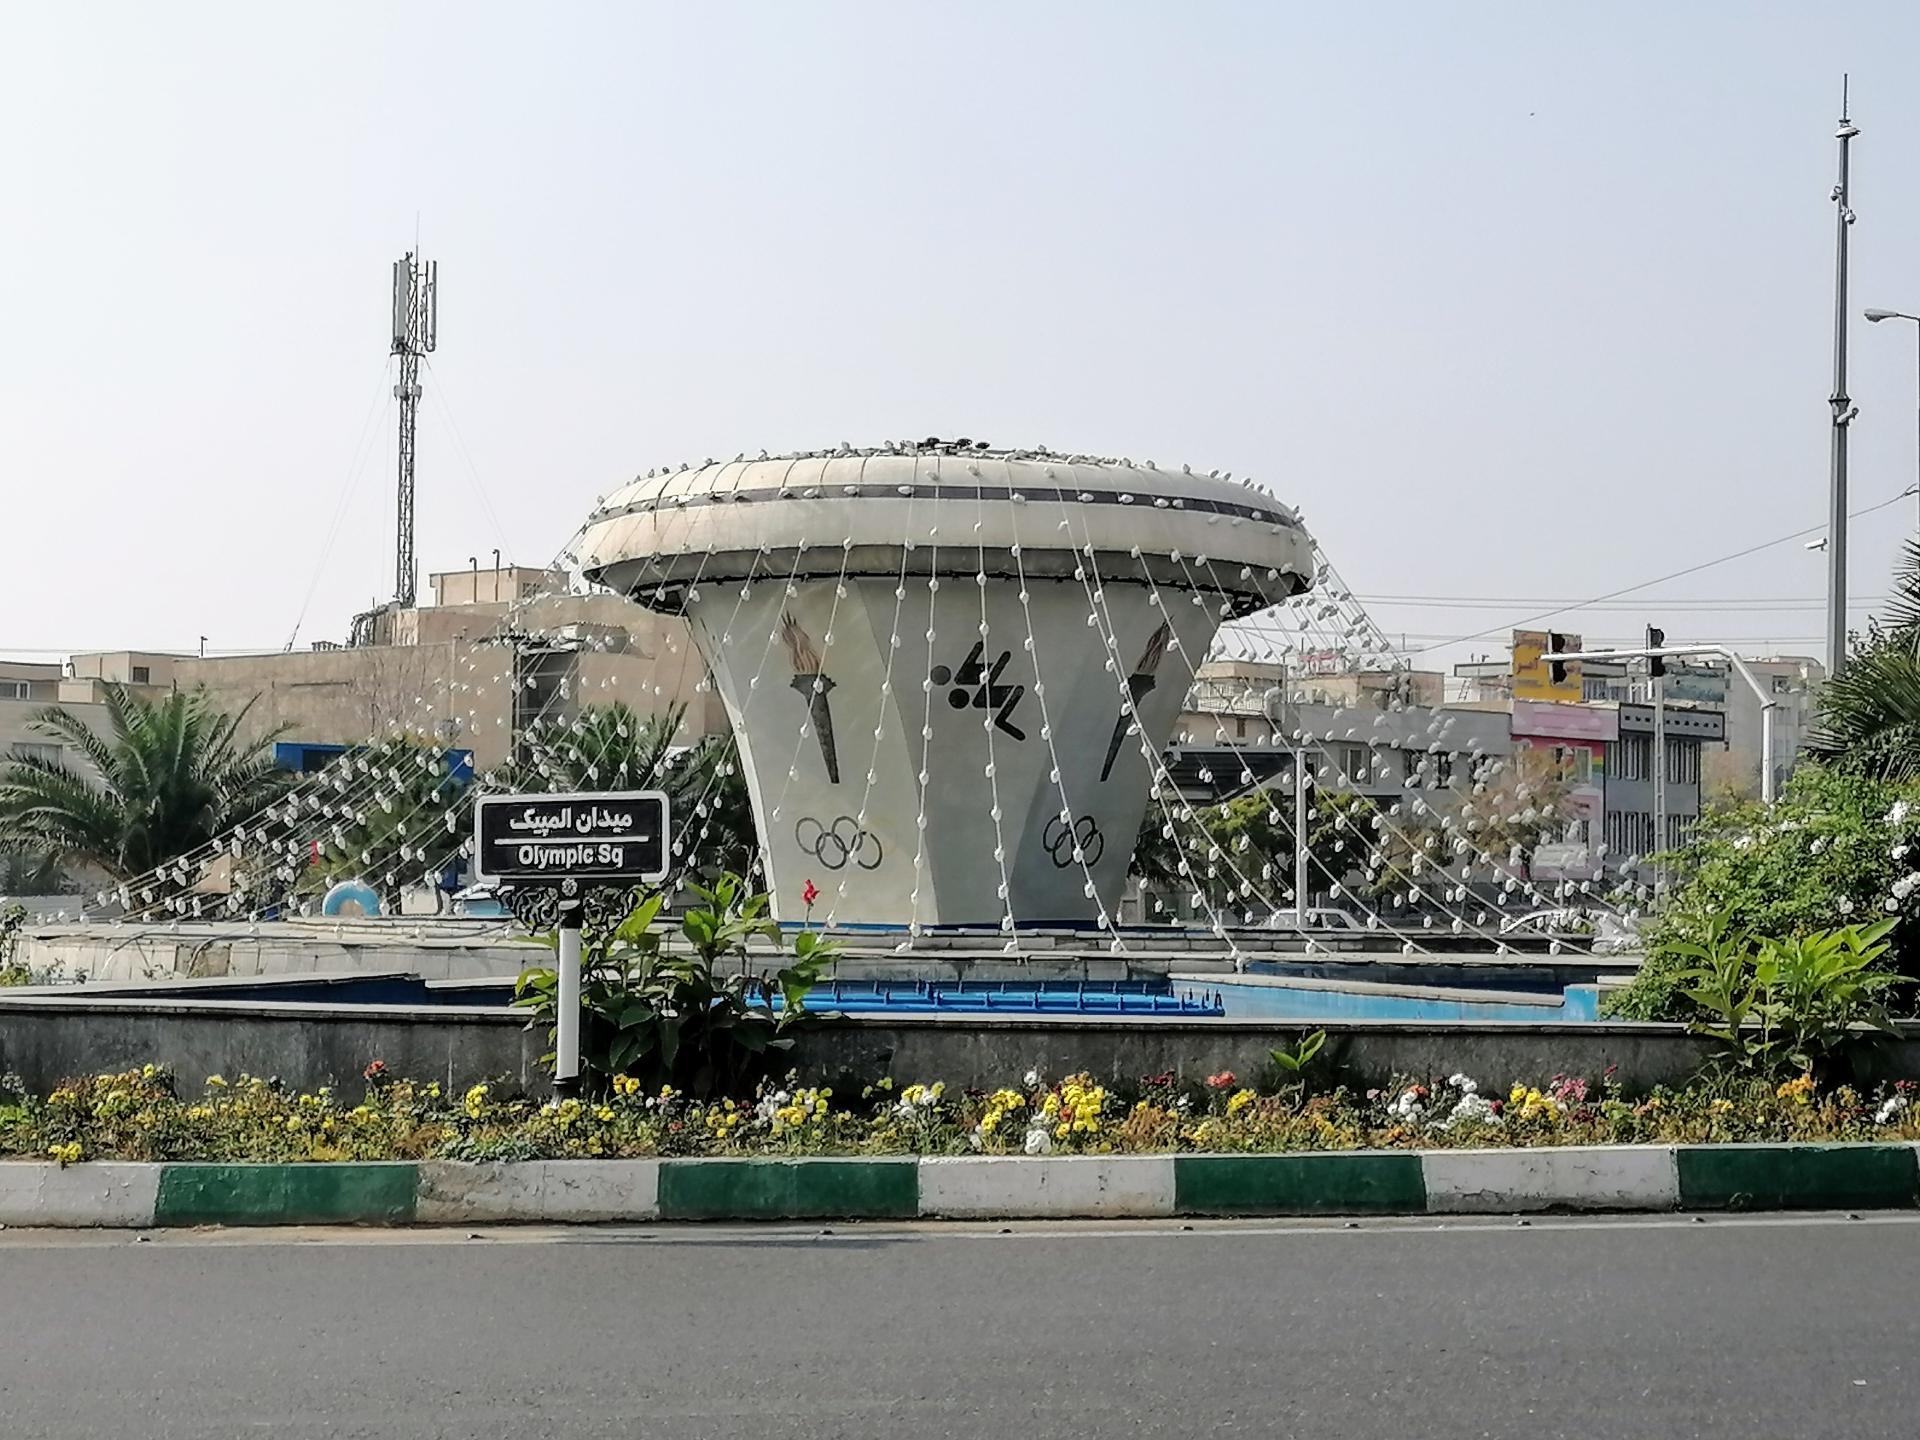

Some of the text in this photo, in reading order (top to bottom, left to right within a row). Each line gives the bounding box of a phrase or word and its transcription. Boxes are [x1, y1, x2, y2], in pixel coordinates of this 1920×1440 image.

[509, 806, 633, 837] میدان المپیک
[518, 843, 624, 869] Olympic Sq
